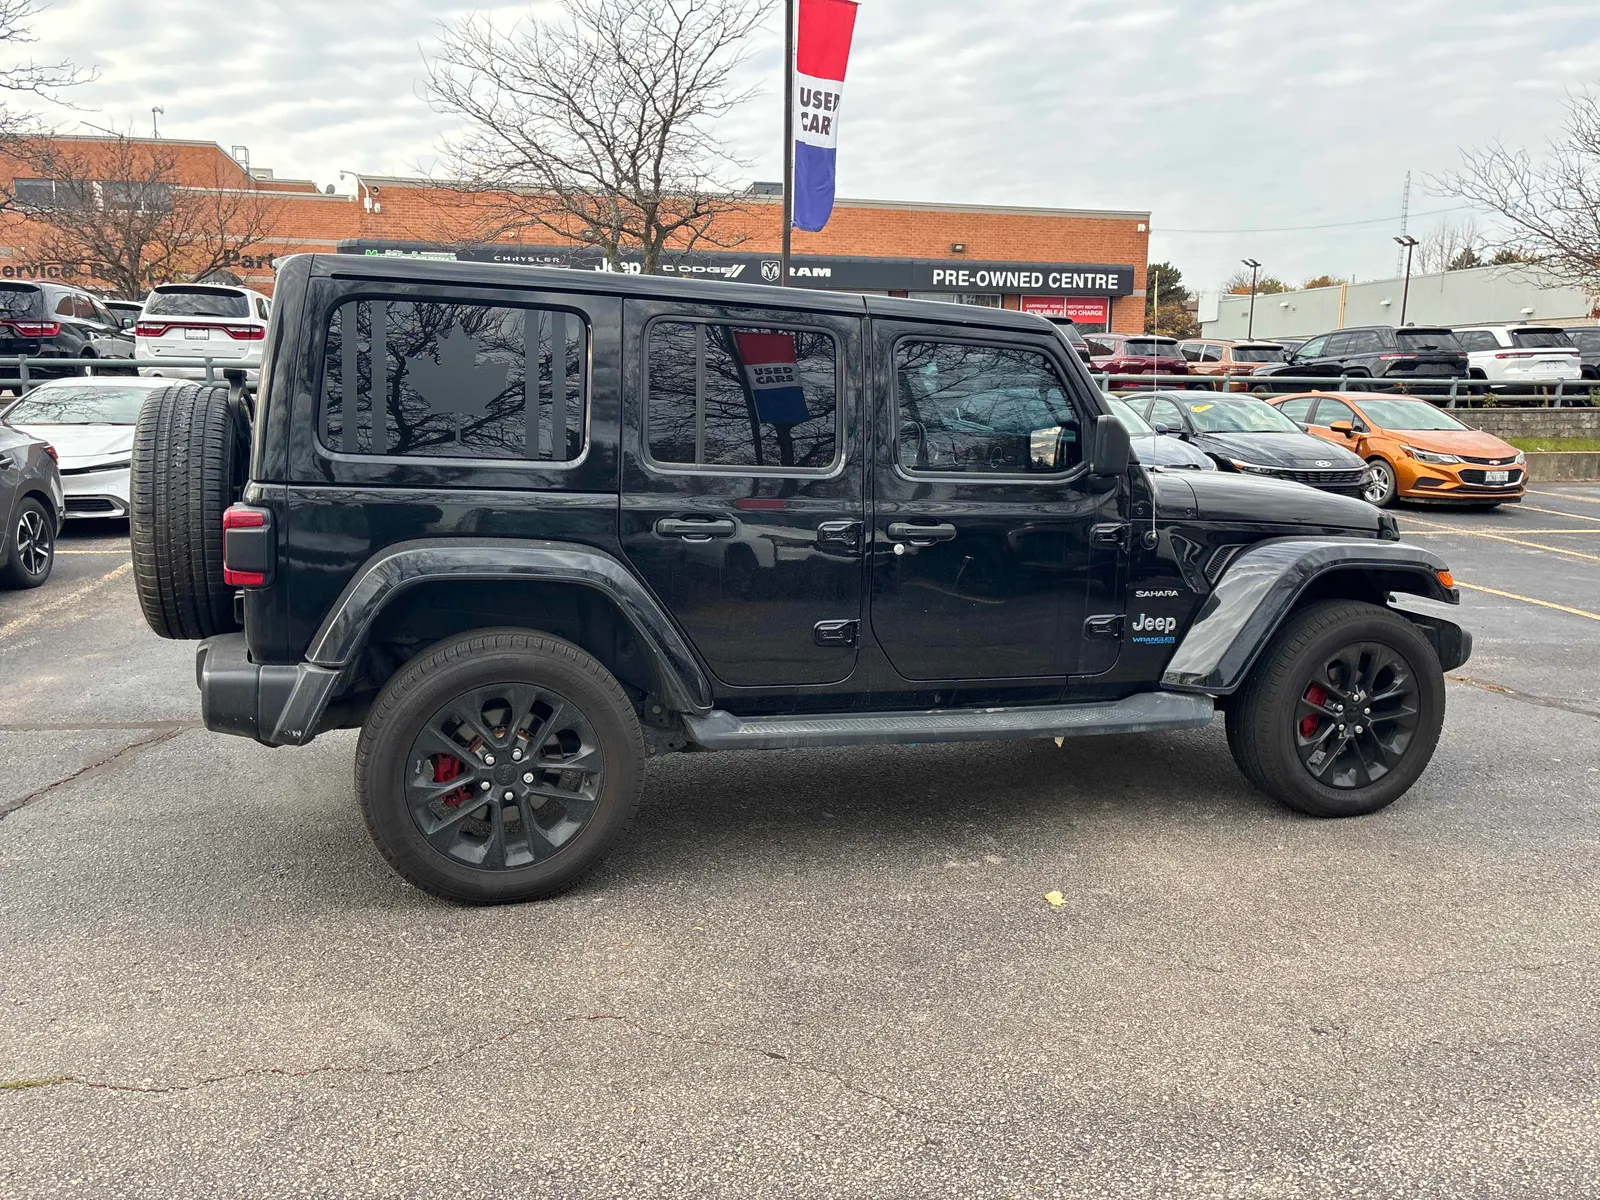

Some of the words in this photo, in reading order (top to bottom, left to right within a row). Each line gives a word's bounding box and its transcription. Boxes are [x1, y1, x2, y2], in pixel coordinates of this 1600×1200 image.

[800, 111, 833, 136] CAR
[494, 255, 560, 263] CHRYSLER
[0, 263, 75, 279] ervice
[662, 264, 735, 274] DODGE
[932, 269, 1043, 288] PRE-OWNED
[1048, 273, 1119, 290] CENTRE
[754, 367, 793, 375] USED
[756, 375, 794, 384] CARS
[1132, 613, 1176, 633] Jeep
